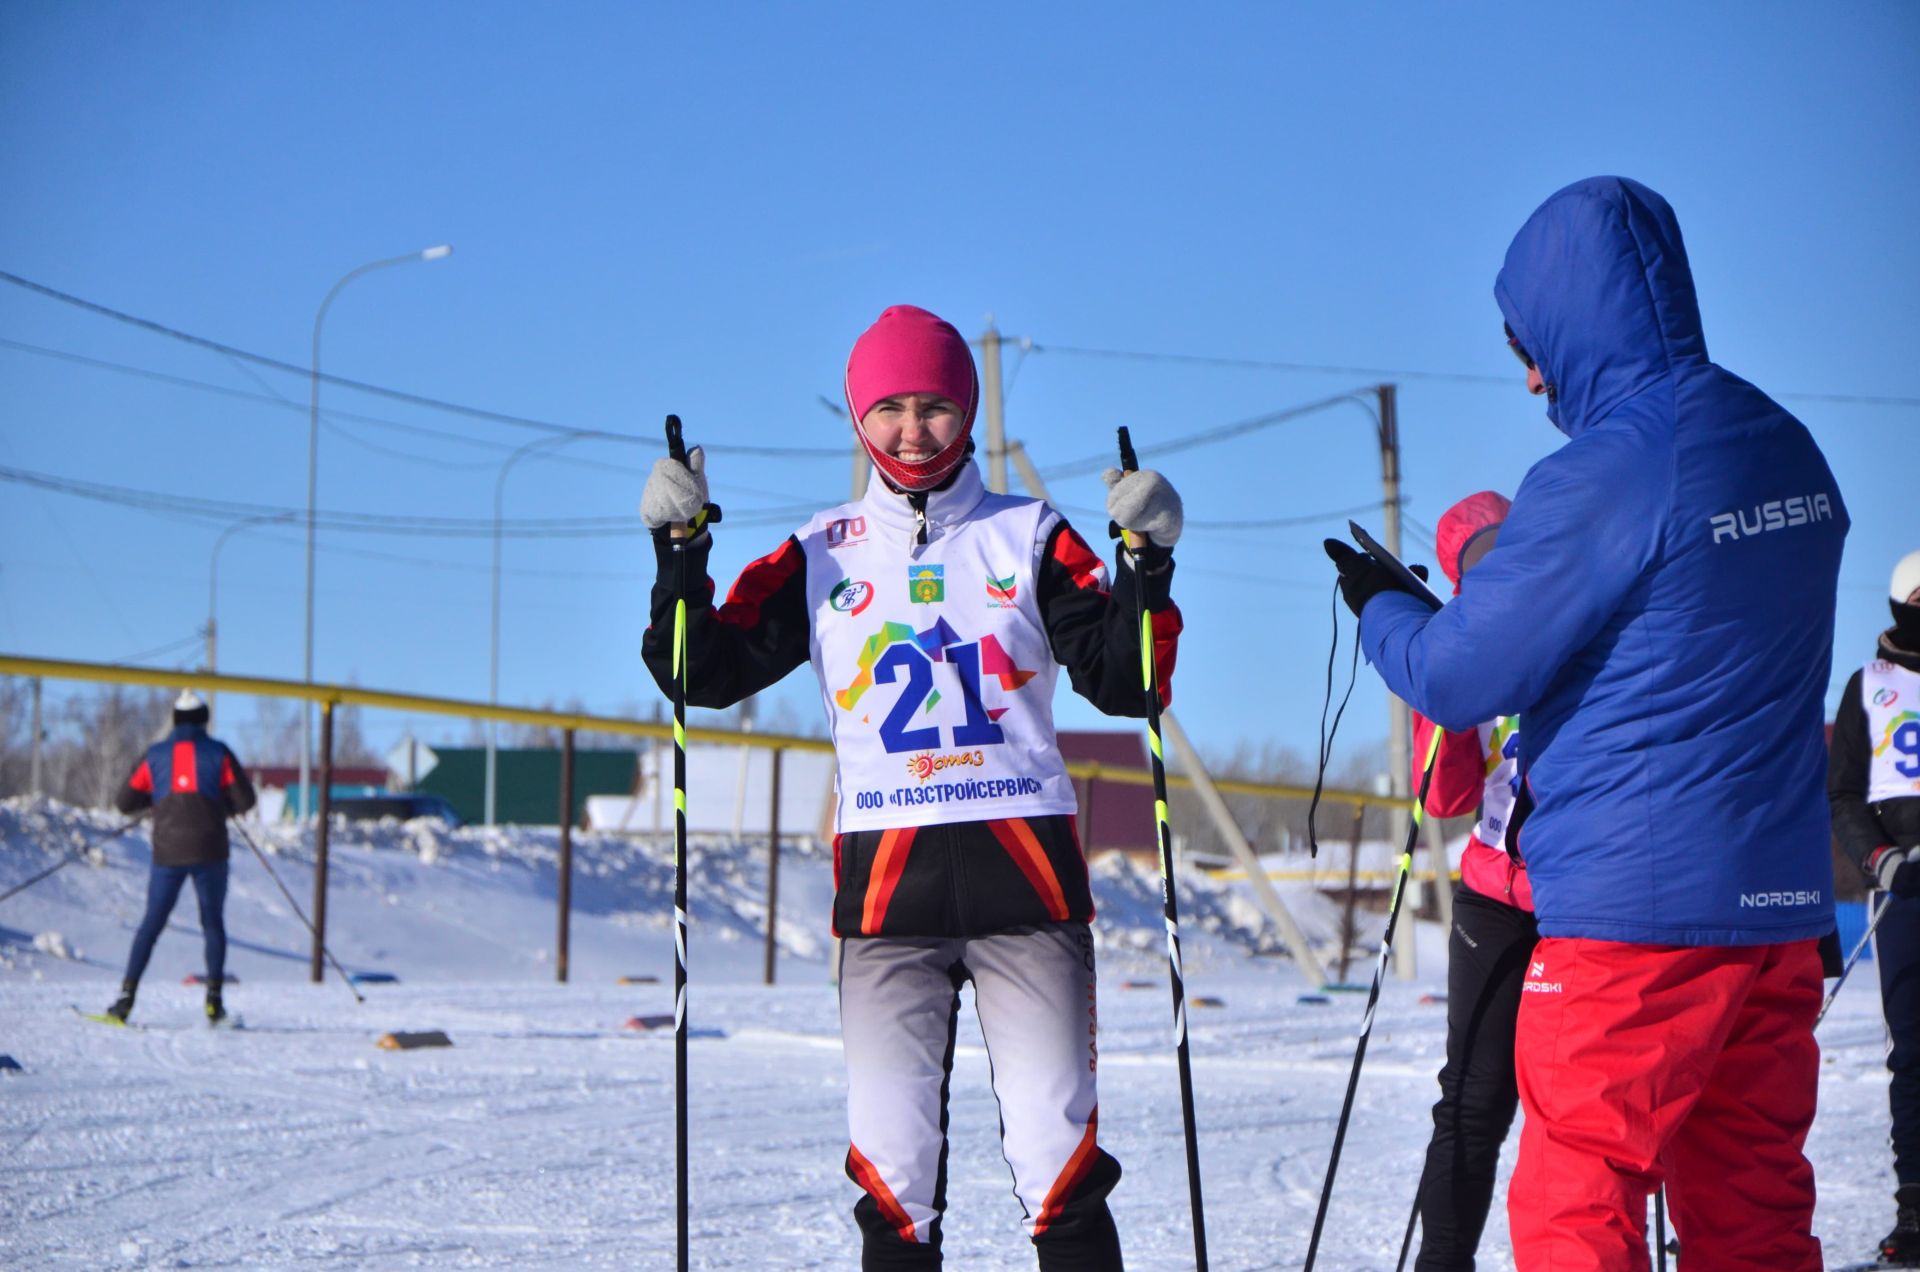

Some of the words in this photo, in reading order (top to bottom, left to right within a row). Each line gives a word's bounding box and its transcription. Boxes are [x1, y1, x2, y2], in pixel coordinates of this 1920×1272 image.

[1710, 493, 1832, 544] RUSSIA
[874, 641, 1005, 754] 21
[1893, 722, 1920, 778] 9
[856, 791, 883, 809] ООО
[890, 777, 1042, 807] «ГАЗСТРОЙСЕРВИС»
[1740, 890, 1820, 907] NORDSKI
